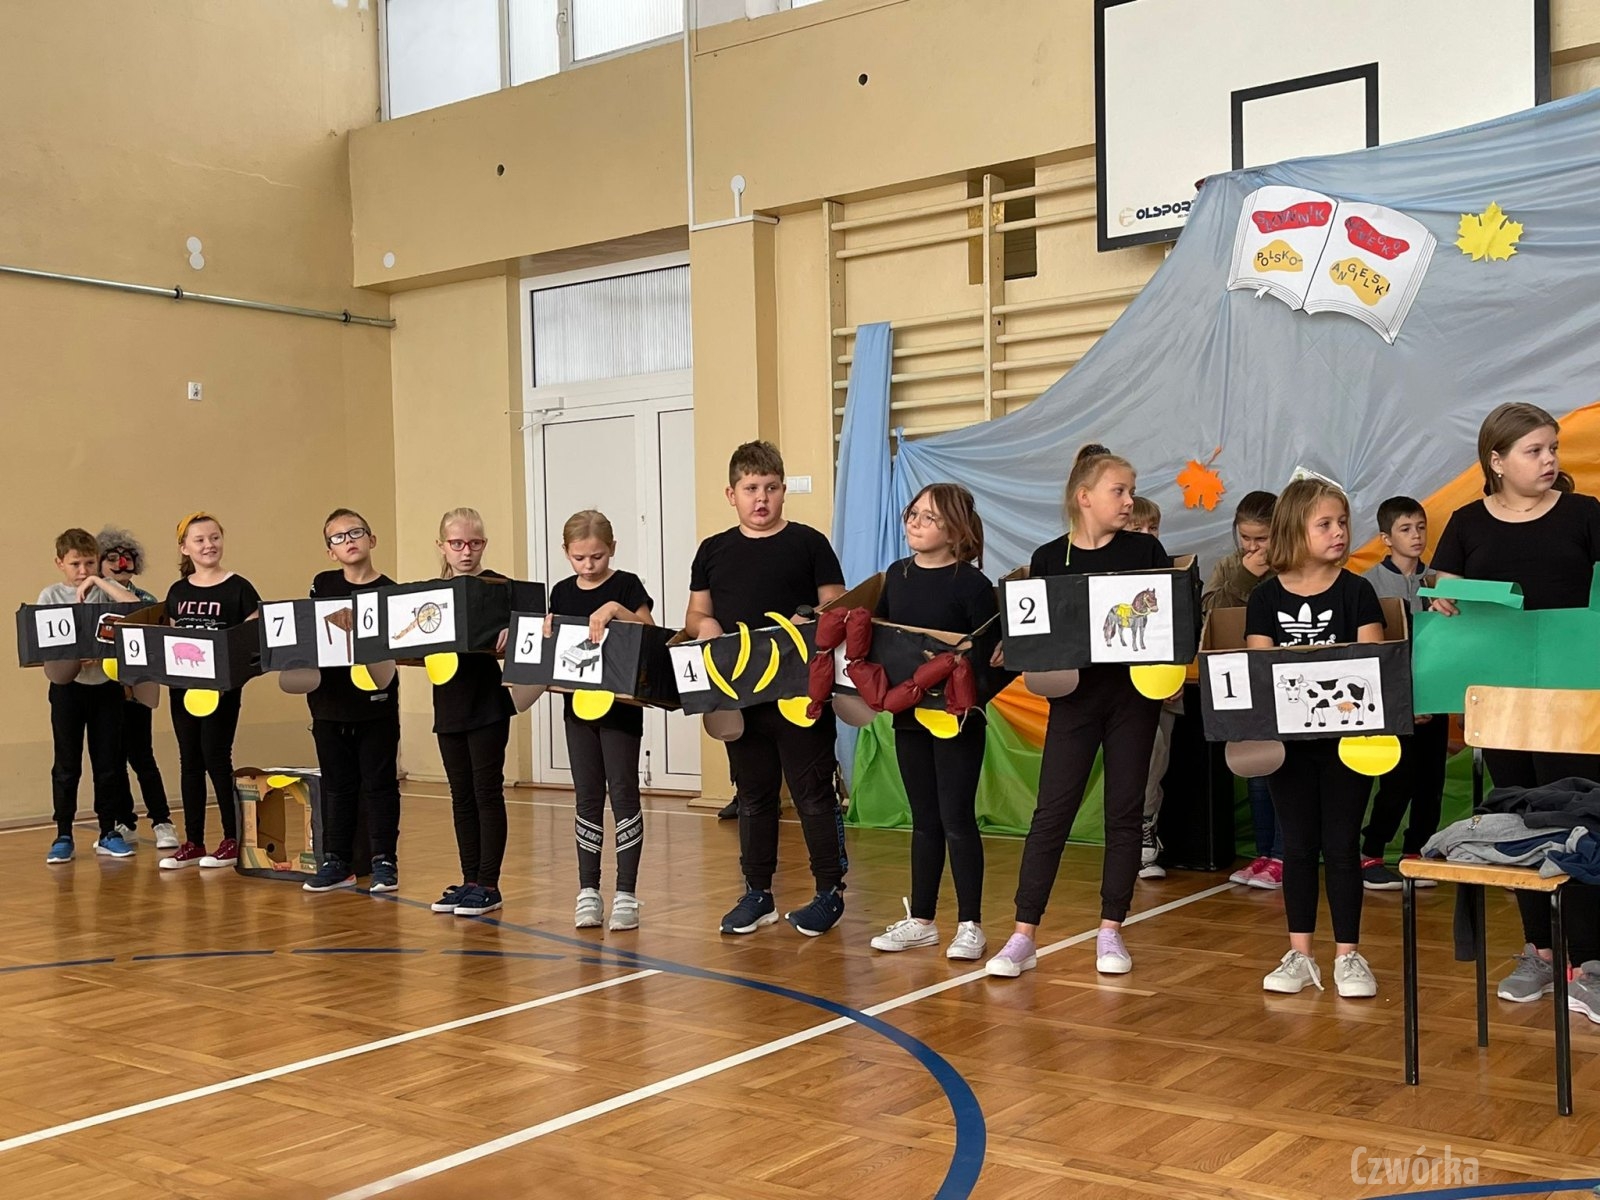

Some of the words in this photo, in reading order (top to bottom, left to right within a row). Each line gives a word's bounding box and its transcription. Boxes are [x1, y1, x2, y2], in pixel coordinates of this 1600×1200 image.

[1257, 250, 1303, 267] POLSKO-
[1331, 262, 1391, 296] ANGIELSKI
[363, 606, 374, 630] 6
[1019, 596, 1037, 625] 2
[46, 618, 71, 638] 10
[272, 616, 285, 637] 7
[129, 640, 140, 658] 9
[520, 632, 535, 655] 5
[683, 660, 698, 682] 4
[1221, 670, 1237, 699] 1
